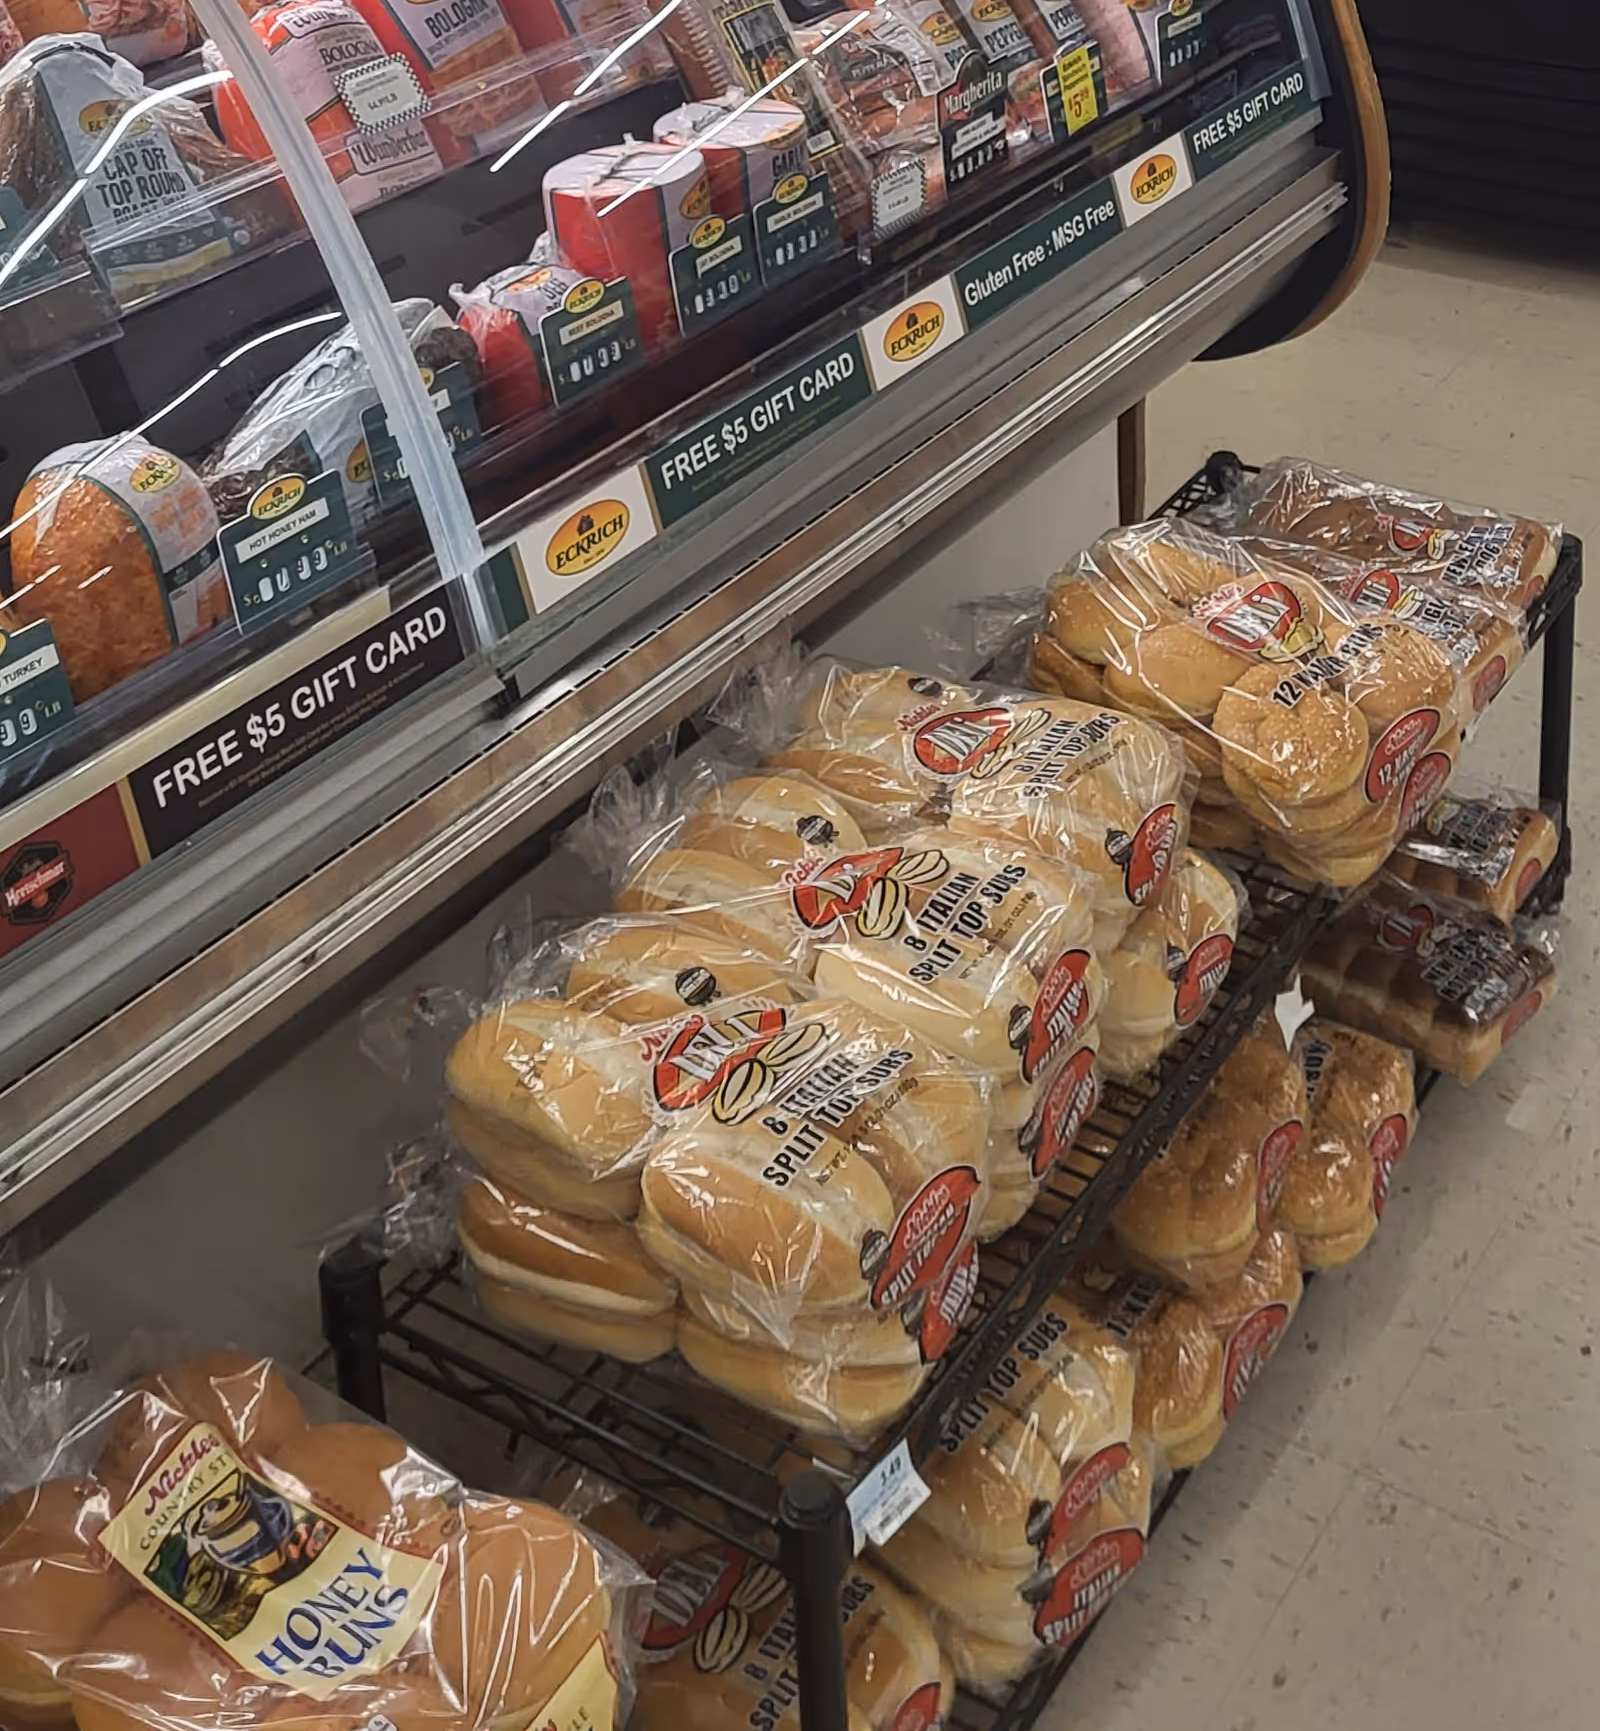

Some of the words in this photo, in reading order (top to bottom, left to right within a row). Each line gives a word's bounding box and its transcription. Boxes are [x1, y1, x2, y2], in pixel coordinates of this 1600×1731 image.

[945, 71, 1002, 114] Margherita
[1193, 125, 1226, 155] FREE
[1226, 111, 1243, 138] $5
[1243, 96, 1269, 123] GIFT
[1270, 71, 1305, 108] CARD
[96, 179, 133, 208] TOP
[136, 171, 186, 200] ROUND
[104, 152, 138, 181] CAP
[142, 147, 169, 172] OFF
[1137, 166, 1174, 200] ECKRICH
[964, 264, 1012, 307] Gluten
[1012, 245, 1047, 283] Free
[1052, 215, 1085, 253] MSG
[1085, 199, 1116, 231] Free
[891, 314, 941, 356] ECKRICH
[660, 435, 721, 490] FREE
[720, 420, 749, 456] $5
[750, 387, 796, 432] GIFT
[798, 351, 855, 403] CARD
[250, 536, 267, 551] HOT
[268, 520, 298, 541] HONEY
[298, 508, 317, 525] HAM
[257, 485, 301, 517] ECKRICH
[555, 513, 623, 571] ECKRICH
[2, 657, 43, 686] TURKEY
[1272, 681, 1302, 709] 12
[152, 728, 243, 808] FREE
[246, 702, 287, 755] $5
[290, 656, 357, 720] GIFT
[364, 605, 447, 675] CARD
[1022, 761, 1066, 799] SPLIT
[1055, 735, 1092, 760] TOP
[1024, 719, 1078, 763] ITALIAN
[908, 940, 962, 984] SPLIT
[951, 899, 987, 940] TOP
[981, 863, 1027, 904] SUBS
[915, 871, 979, 933] ITALIAN
[903, 934, 928, 953] 8
[761, 1115, 789, 1135] 8
[779, 1052, 856, 1117] ITALIAN
[762, 1124, 825, 1187] SPLIT
[815, 1089, 859, 1126] TOP
[855, 1048, 914, 1088] SUBS
[940, 1396, 989, 1455] SPLIT
[987, 1348, 1020, 1396] TOP
[1016, 1311, 1068, 1362] SUBS
[145, 1433, 221, 1517] Nickles
[138, 1474, 206, 1552] COUNTRY
[254, 1546, 385, 1676] HONEY
[303, 1583, 409, 1679] BUNS
[744, 1662, 769, 1681] 8
